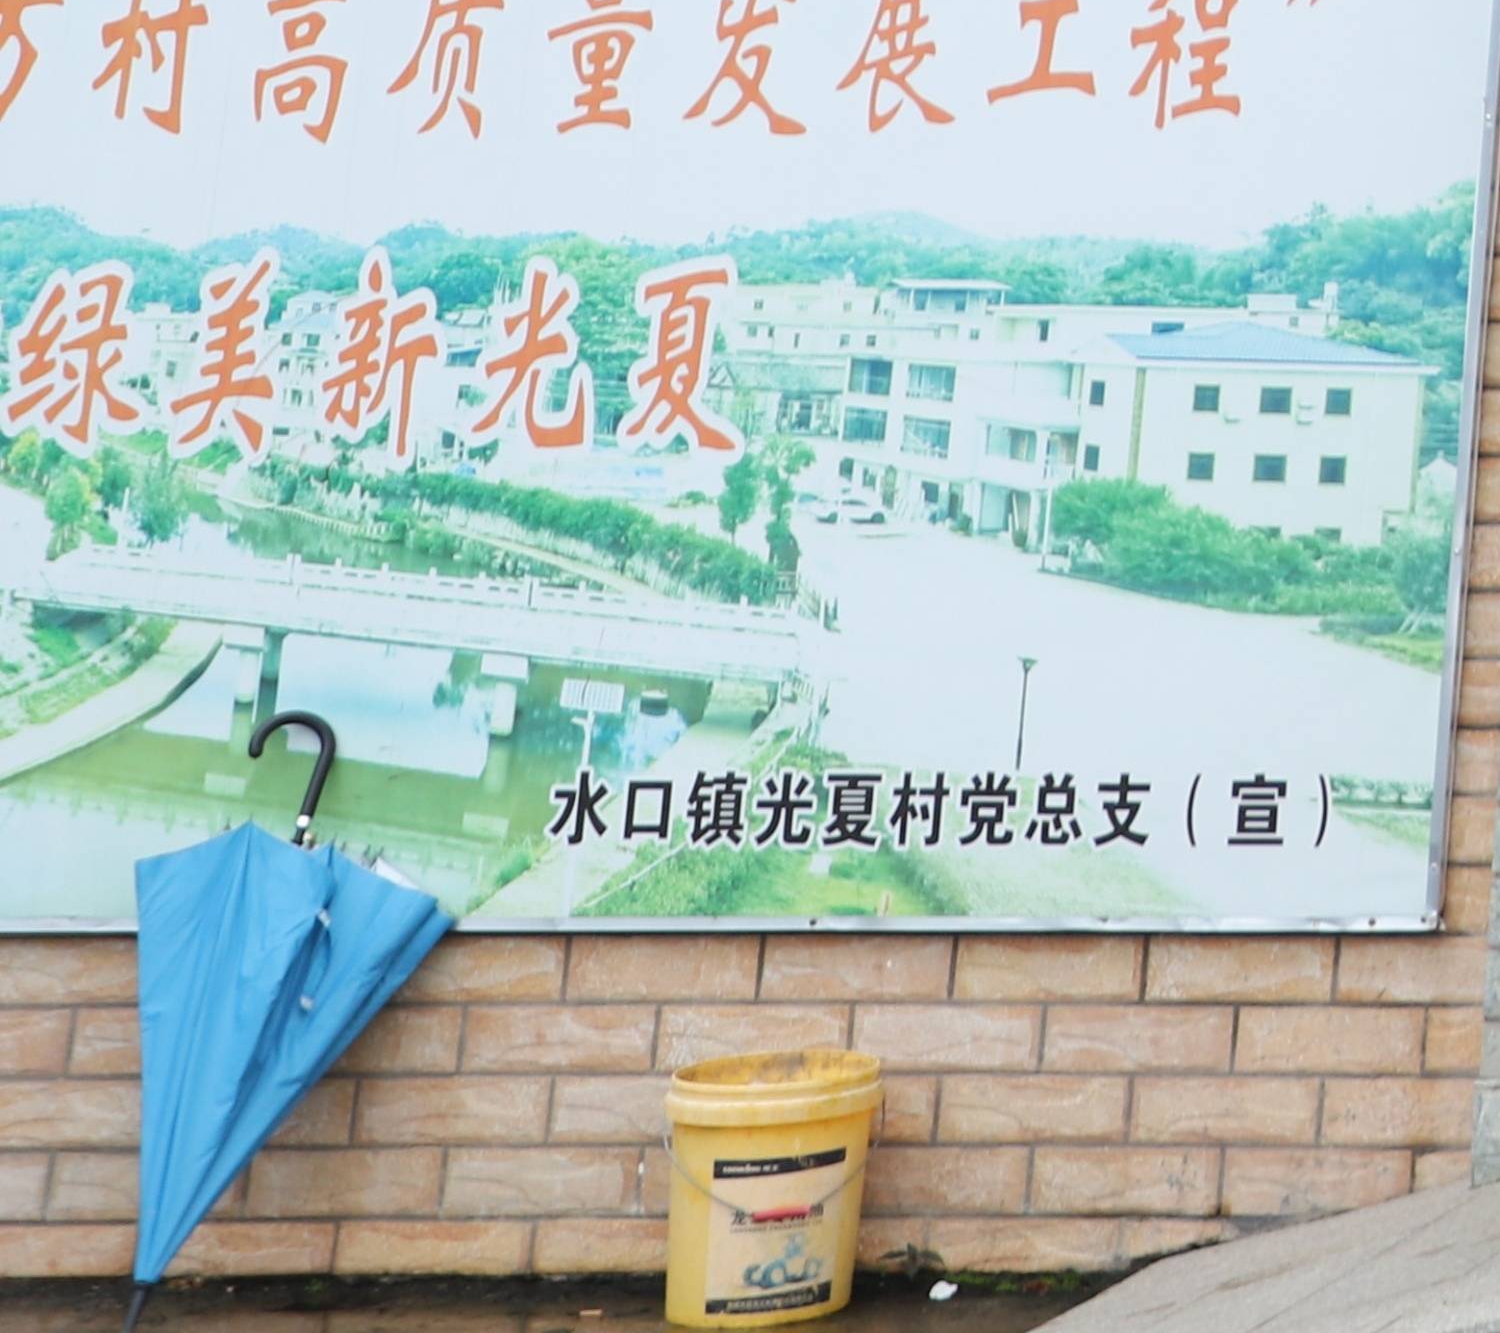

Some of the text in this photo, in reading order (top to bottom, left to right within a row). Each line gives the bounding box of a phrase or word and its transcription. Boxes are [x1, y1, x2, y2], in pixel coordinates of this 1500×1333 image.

[8, 259, 736, 456] 绿美新光夏
[550, 771, 1331, 847] 水口镇光夏村党总支（宣）
